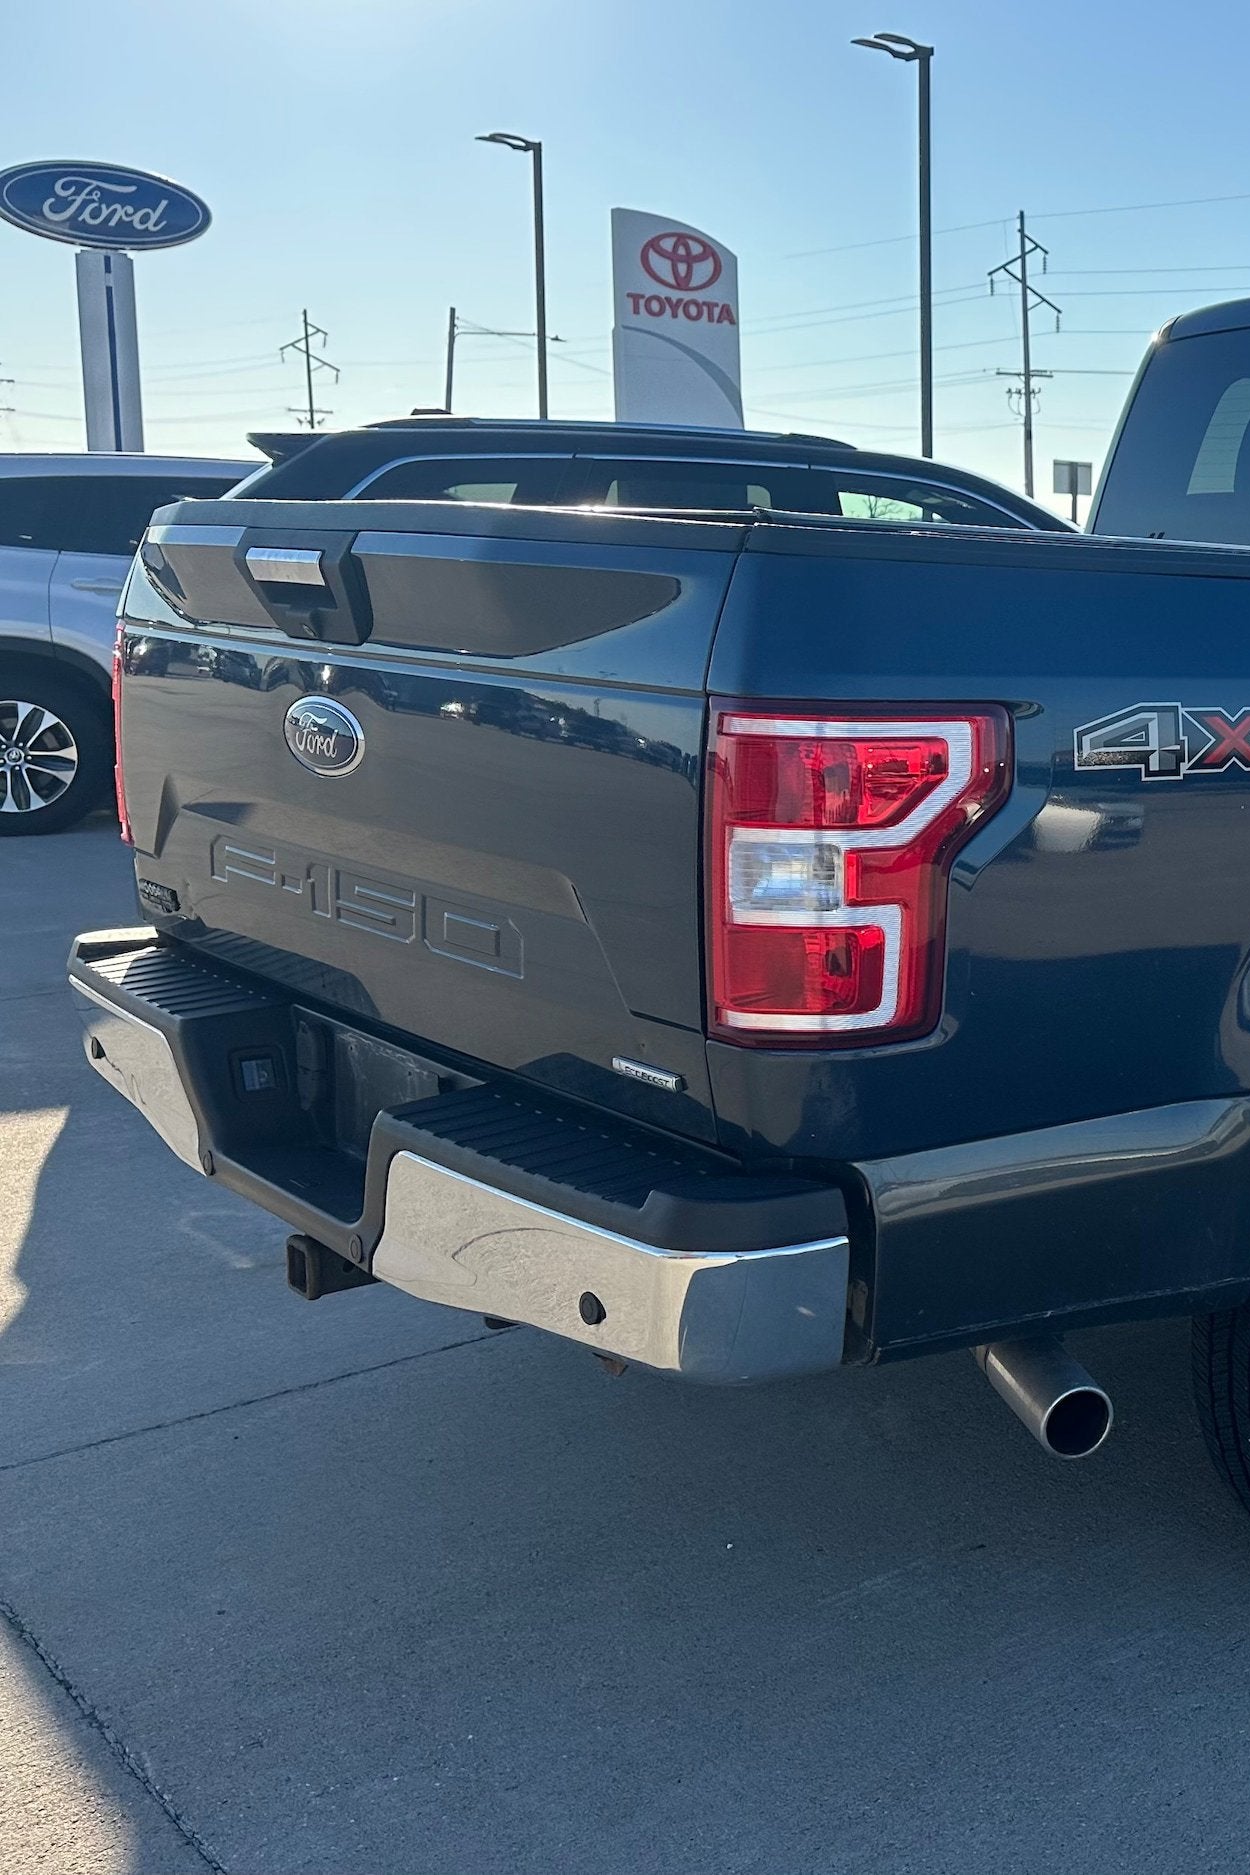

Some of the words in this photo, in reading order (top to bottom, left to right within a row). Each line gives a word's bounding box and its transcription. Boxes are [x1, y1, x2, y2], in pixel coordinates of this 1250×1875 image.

[42, 176, 169, 232] Ford
[626, 292, 736, 325] TOYOTA
[295, 711, 338, 758] Ford
[209, 833, 525, 980] F-150
